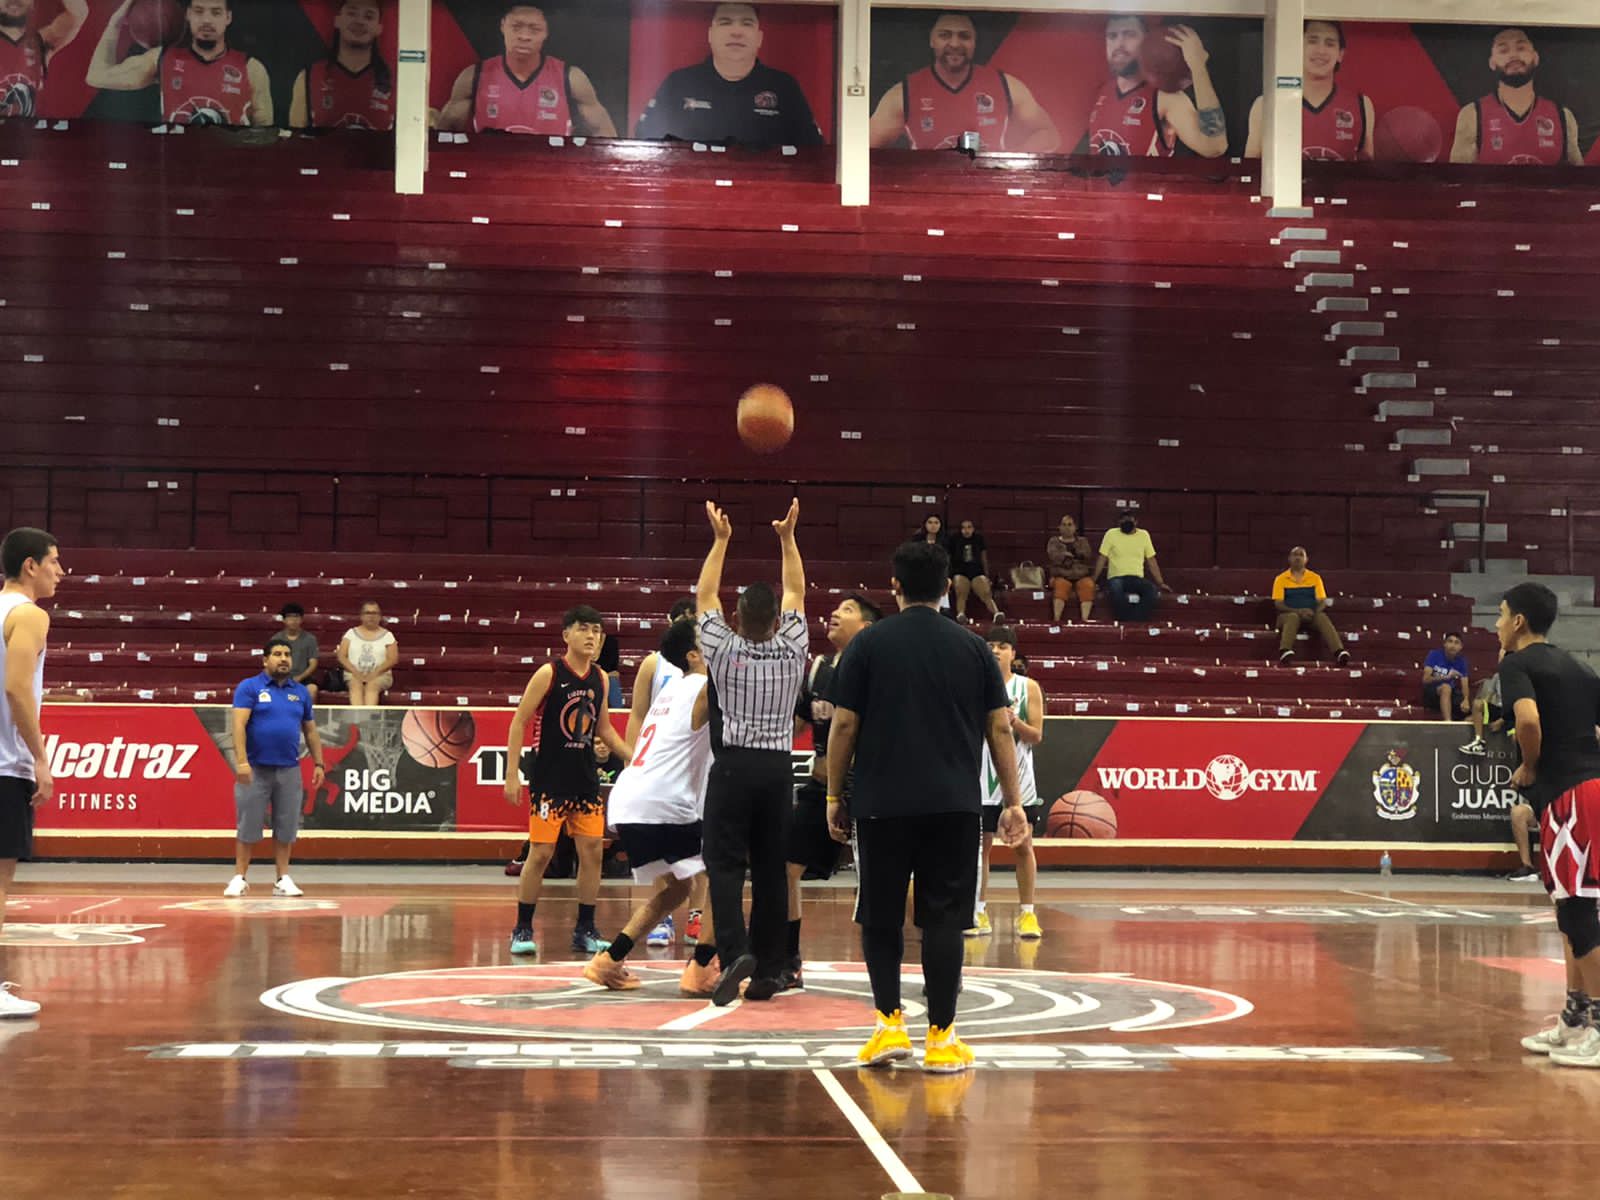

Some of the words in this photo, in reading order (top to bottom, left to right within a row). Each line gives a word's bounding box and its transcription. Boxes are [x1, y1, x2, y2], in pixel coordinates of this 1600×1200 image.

[41, 735, 199, 779] lcatraz
[344, 768, 391, 791] BIG
[1097, 768, 1206, 791] WORLD
[1248, 769, 1318, 792] GYM
[1451, 763, 1513, 785] CIUD
[58, 793, 138, 810] FITNESS
[1451, 784, 1521, 809] JUÁR
